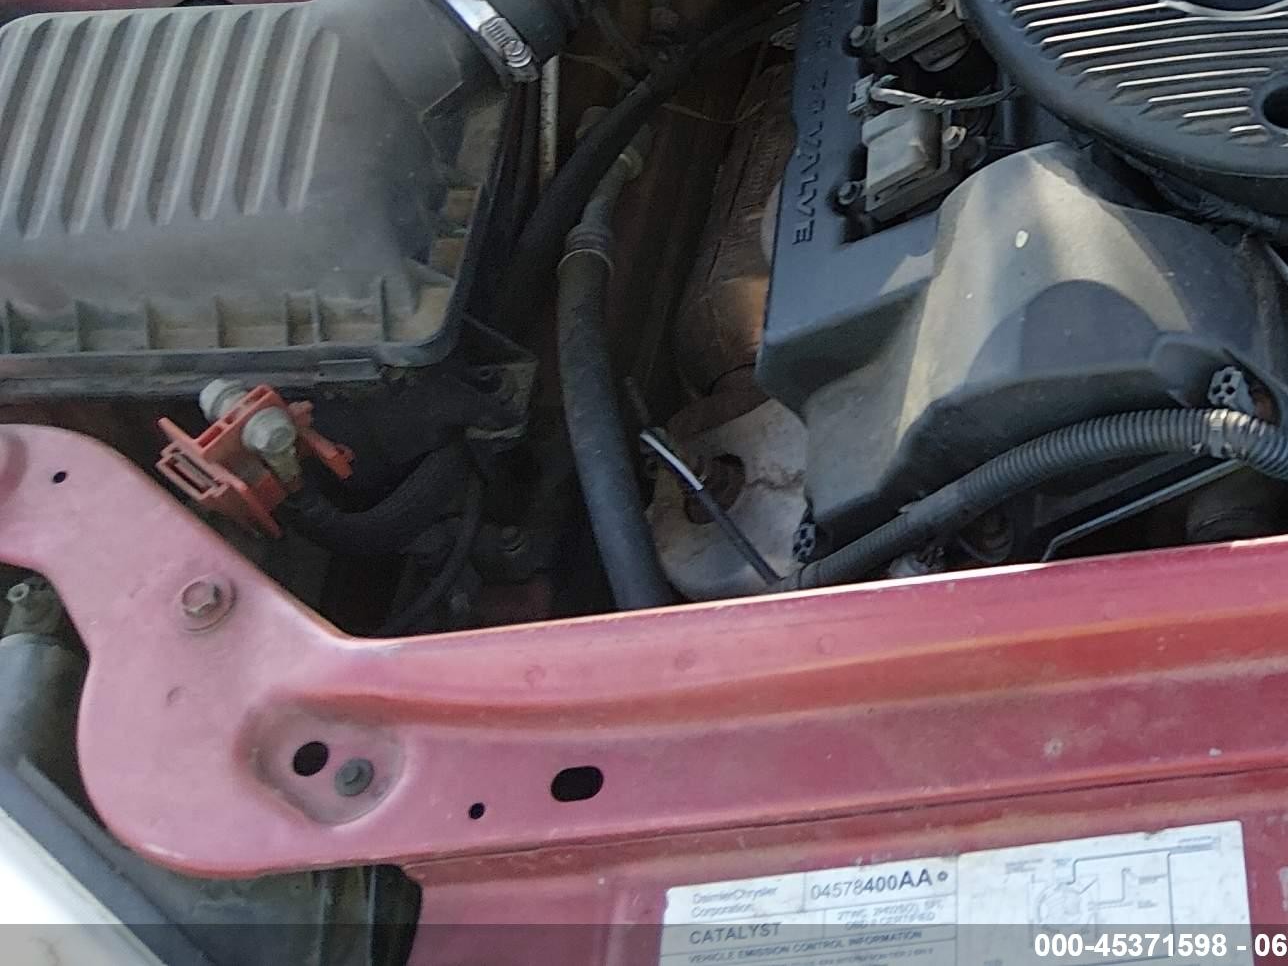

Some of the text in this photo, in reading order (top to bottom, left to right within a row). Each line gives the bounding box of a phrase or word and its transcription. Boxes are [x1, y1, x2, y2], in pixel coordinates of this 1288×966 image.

[793, 121, 823, 245] VALVE
[811, 868, 932, 901] 04578400AA
[689, 922, 782, 945] CATALYST
